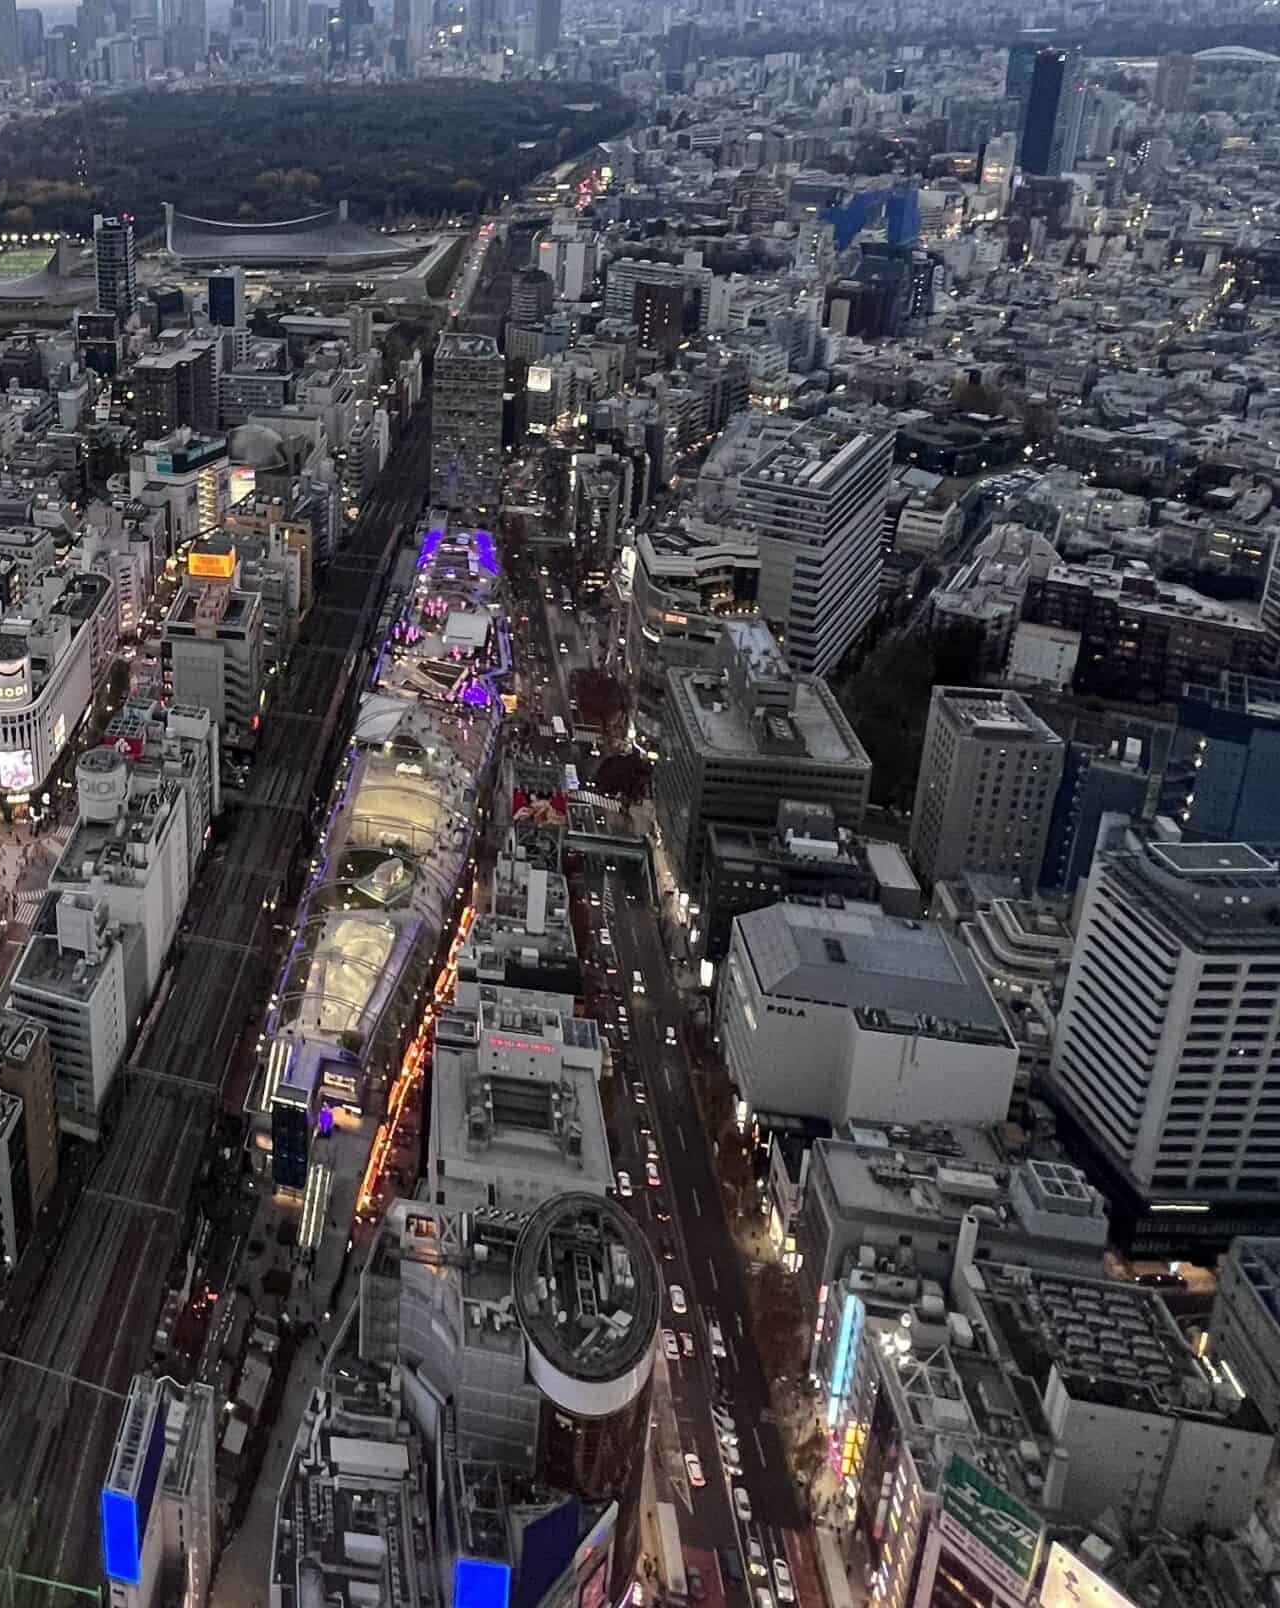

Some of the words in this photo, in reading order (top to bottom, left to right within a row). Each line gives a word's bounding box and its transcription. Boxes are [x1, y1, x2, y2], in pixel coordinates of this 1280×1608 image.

[767, 1004, 807, 1018] POLA
[942, 1481, 1041, 1550] エイブル
